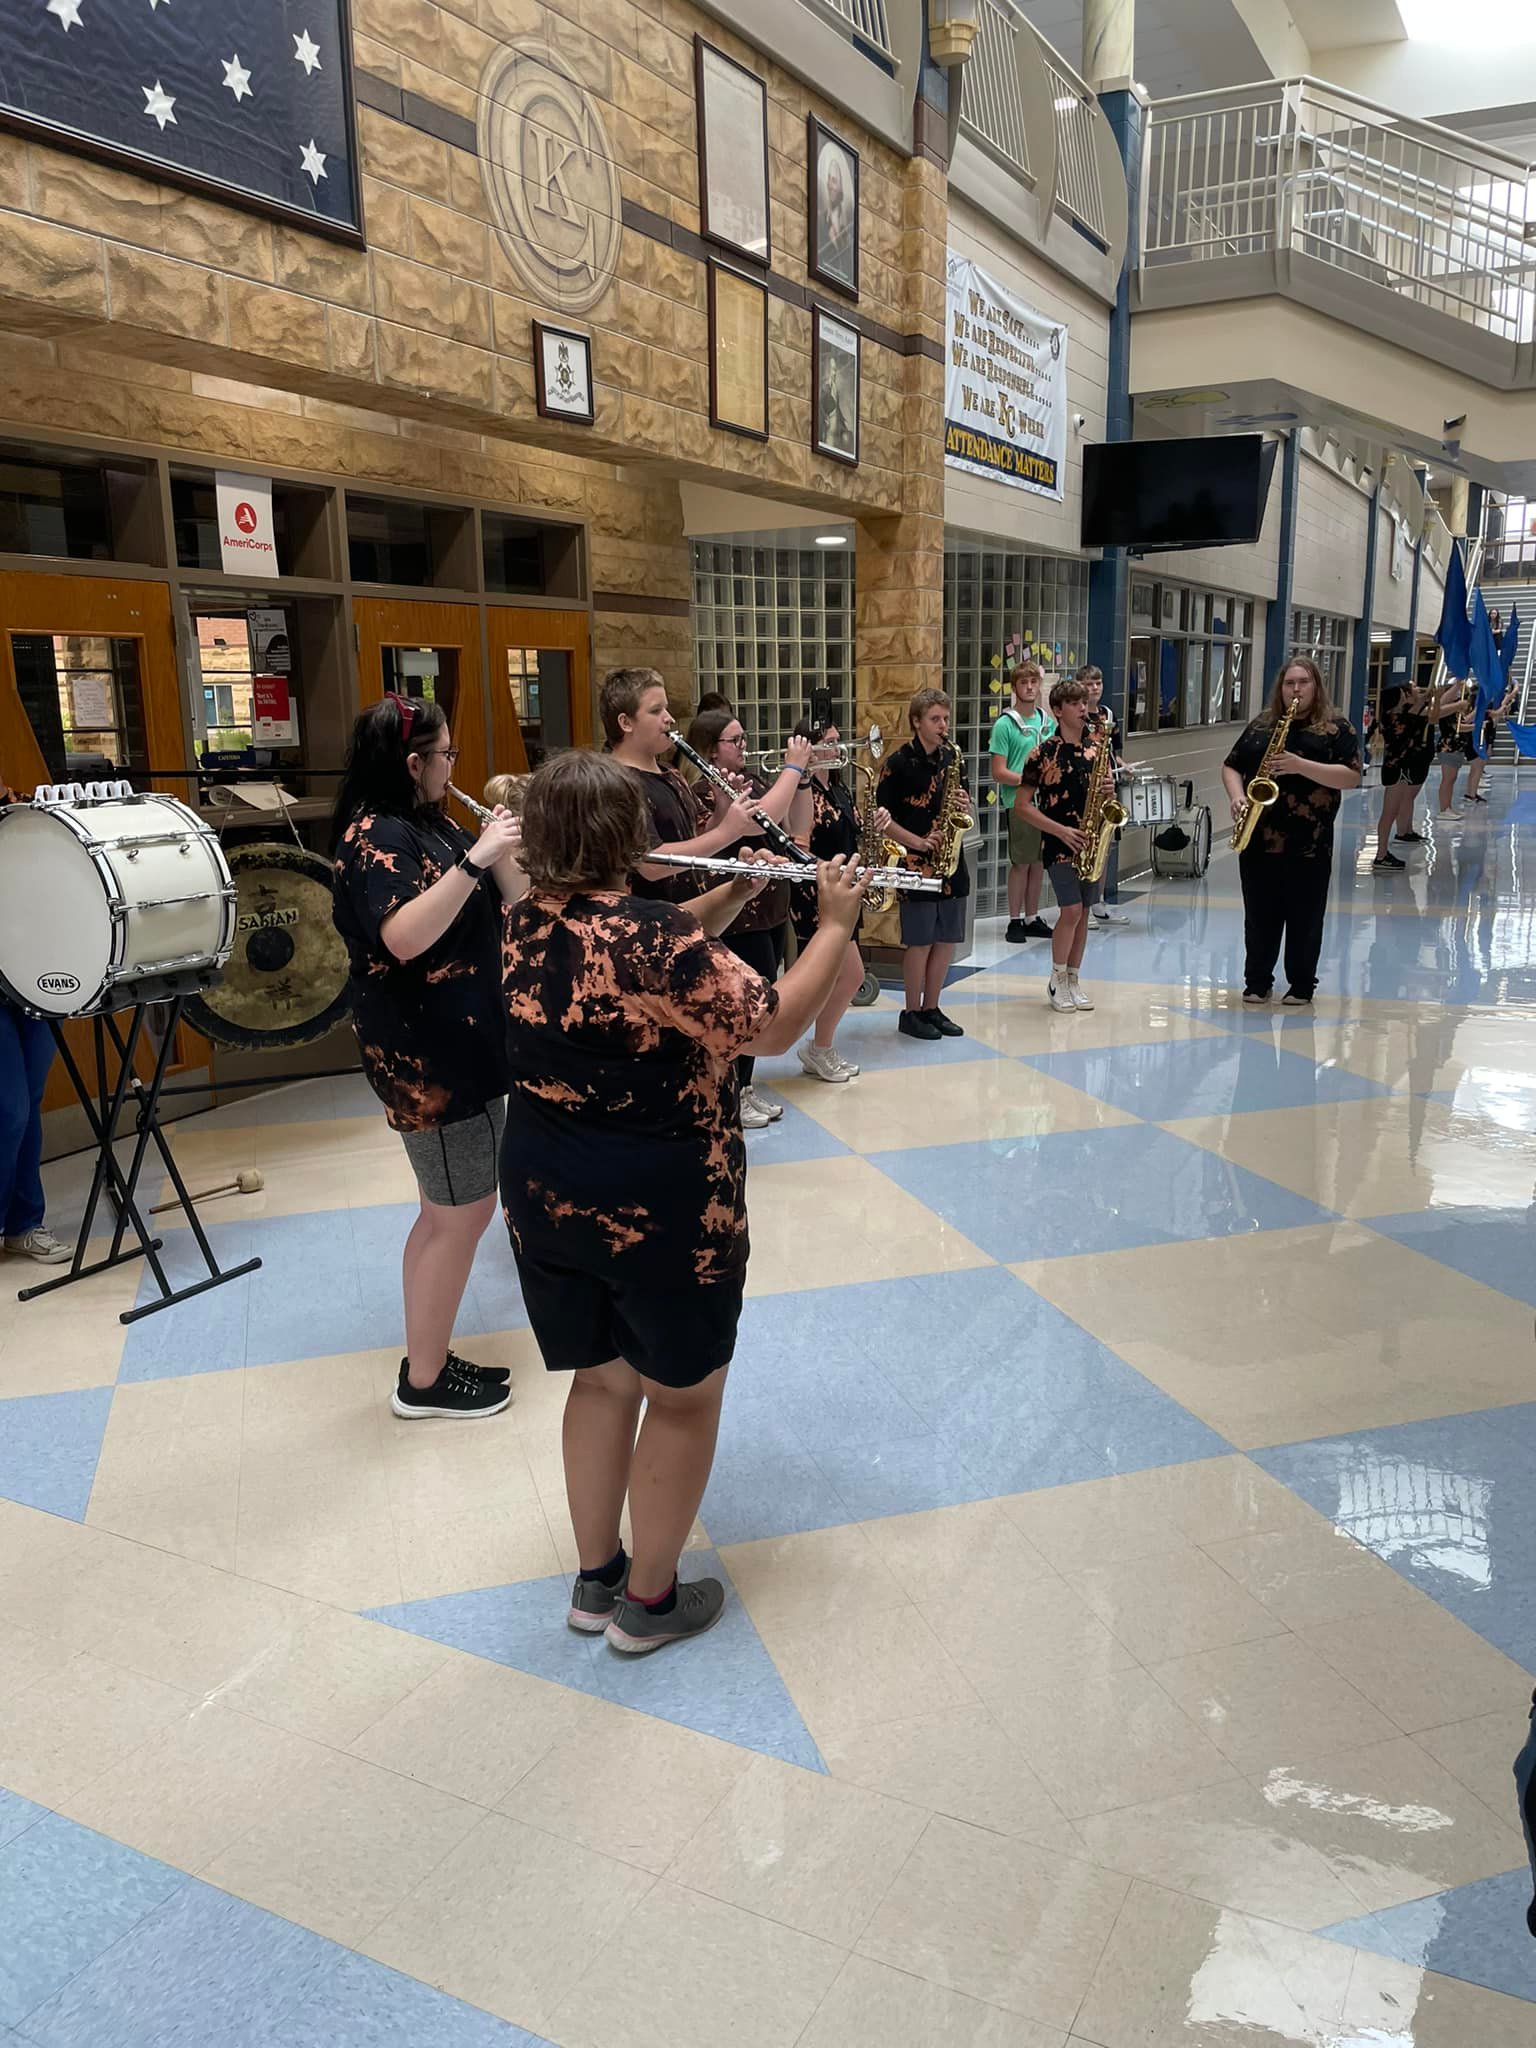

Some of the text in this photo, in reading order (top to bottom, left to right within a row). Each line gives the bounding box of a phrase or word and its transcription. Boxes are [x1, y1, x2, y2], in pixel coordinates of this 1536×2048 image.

[953, 310, 970, 340] WE
[971, 324, 988, 349] ARE
[952, 339, 969, 368] WE
[970, 353, 986, 377] ARE
[961, 384, 979, 412] WE
[980, 395, 996, 419] ARE
[997, 390, 1016, 439] KC
[946, 426, 1055, 485] ATTENDANCE MATTERS
[223, 535, 273, 553] AmeriCorps
[41, 978, 75, 989] EVANS
